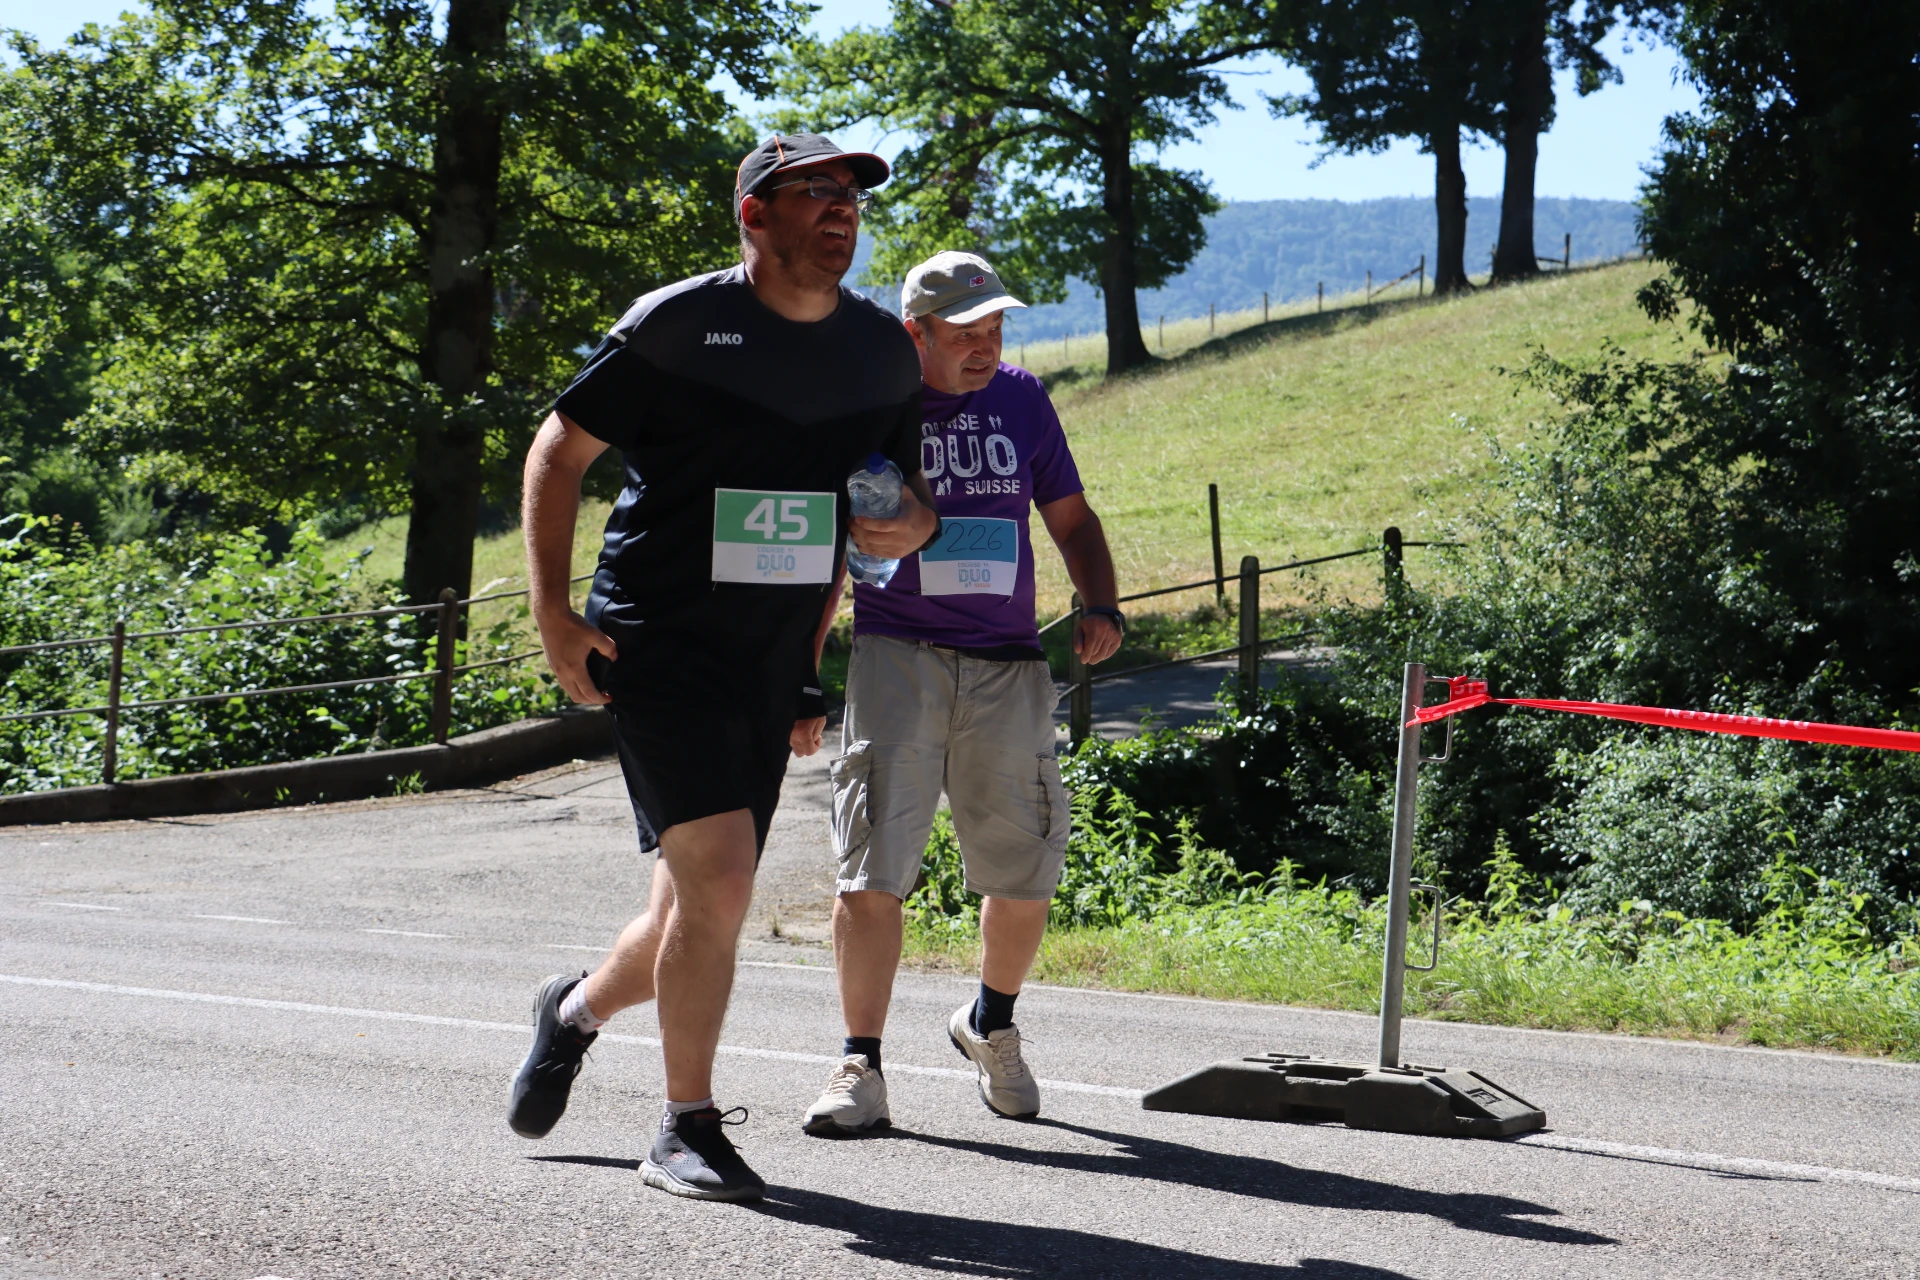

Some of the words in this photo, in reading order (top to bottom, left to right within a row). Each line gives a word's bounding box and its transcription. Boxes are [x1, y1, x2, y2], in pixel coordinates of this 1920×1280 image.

[704, 332, 743, 345] JAKO
[920, 433, 1018, 479] DUO
[965, 479, 1021, 495] SUISSE
[744, 498, 809, 540] 45
[944, 522, 1003, 553] 226
[756, 554, 796, 572] DUO
[958, 568, 991, 583] DUO
